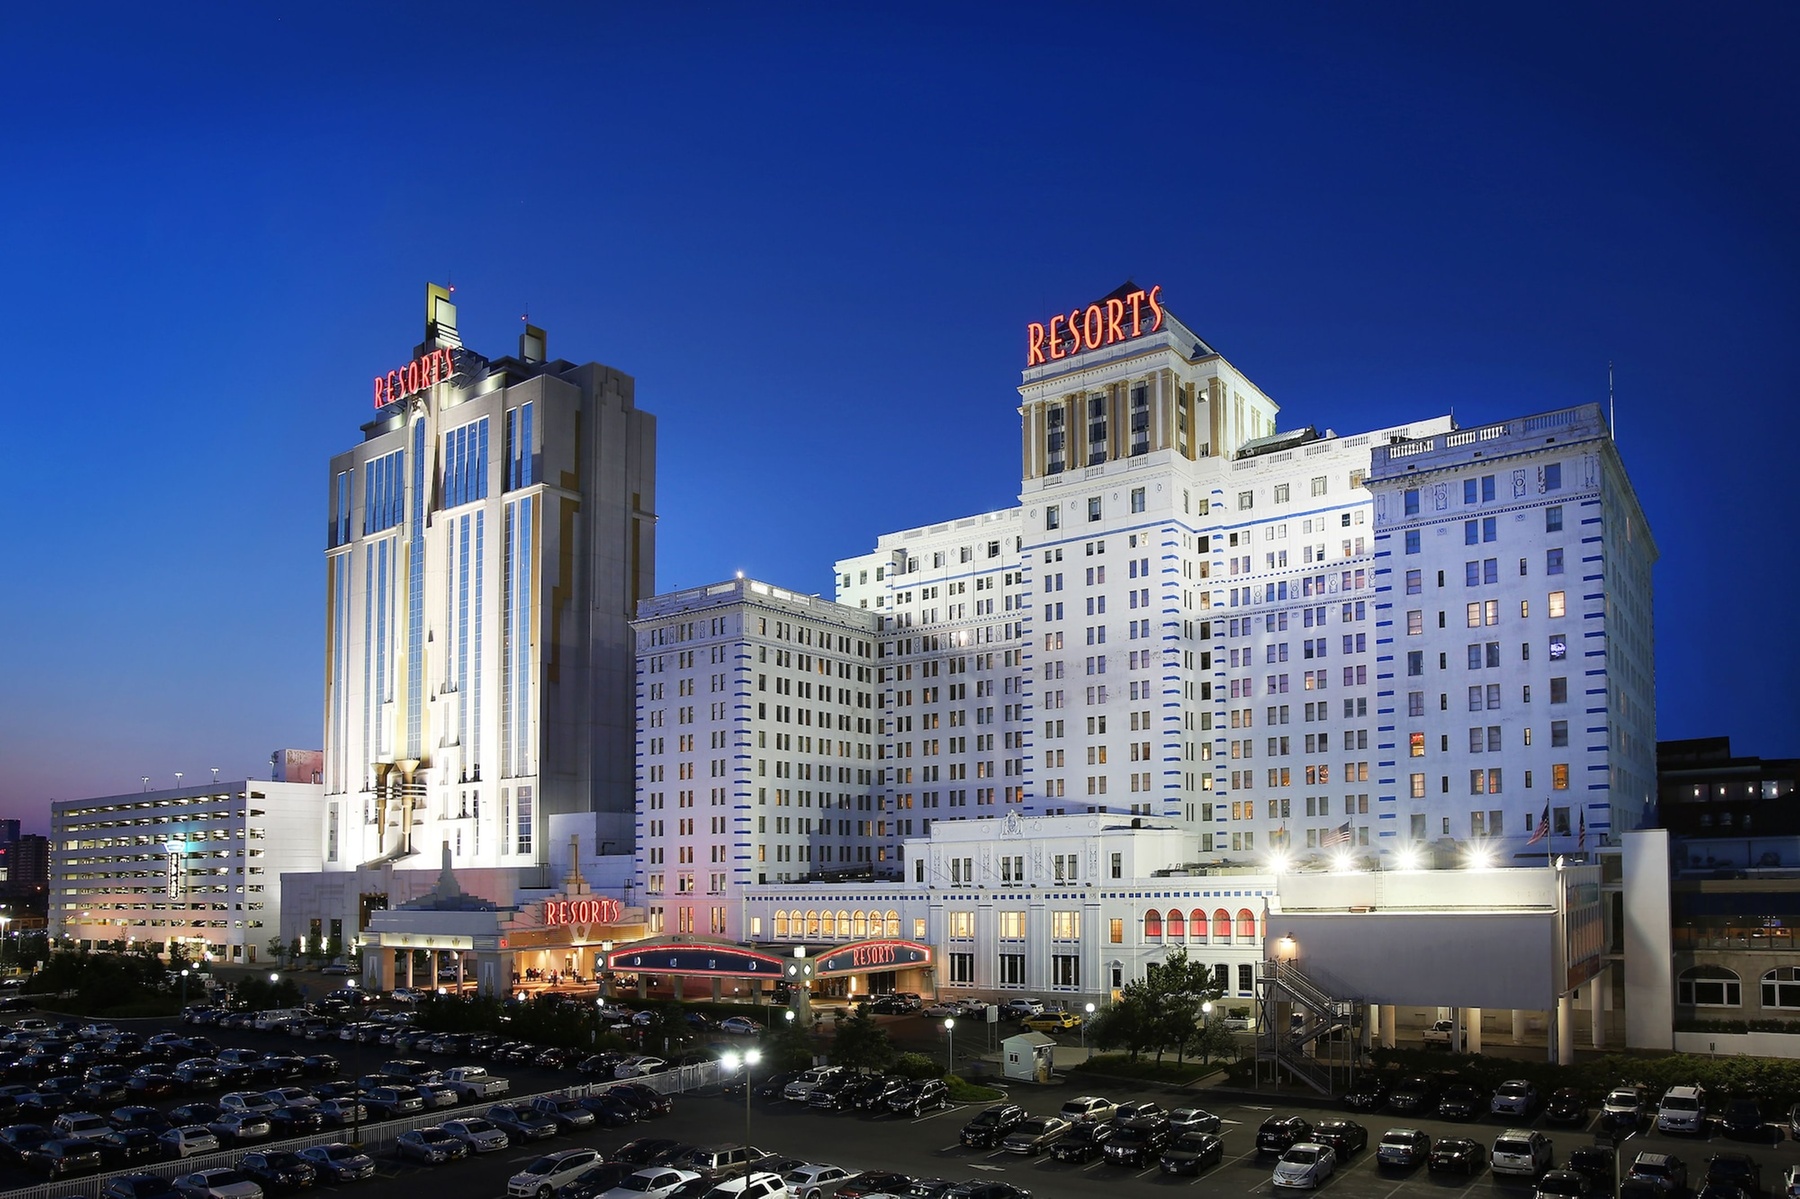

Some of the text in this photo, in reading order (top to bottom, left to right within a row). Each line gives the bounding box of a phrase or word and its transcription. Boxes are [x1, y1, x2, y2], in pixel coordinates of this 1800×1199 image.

[1027, 284, 1163, 367] RESORTS
[373, 344, 455, 409] RESORTS
[546, 899, 619, 925] RESORTS
[853, 945, 896, 967] RESORTS
